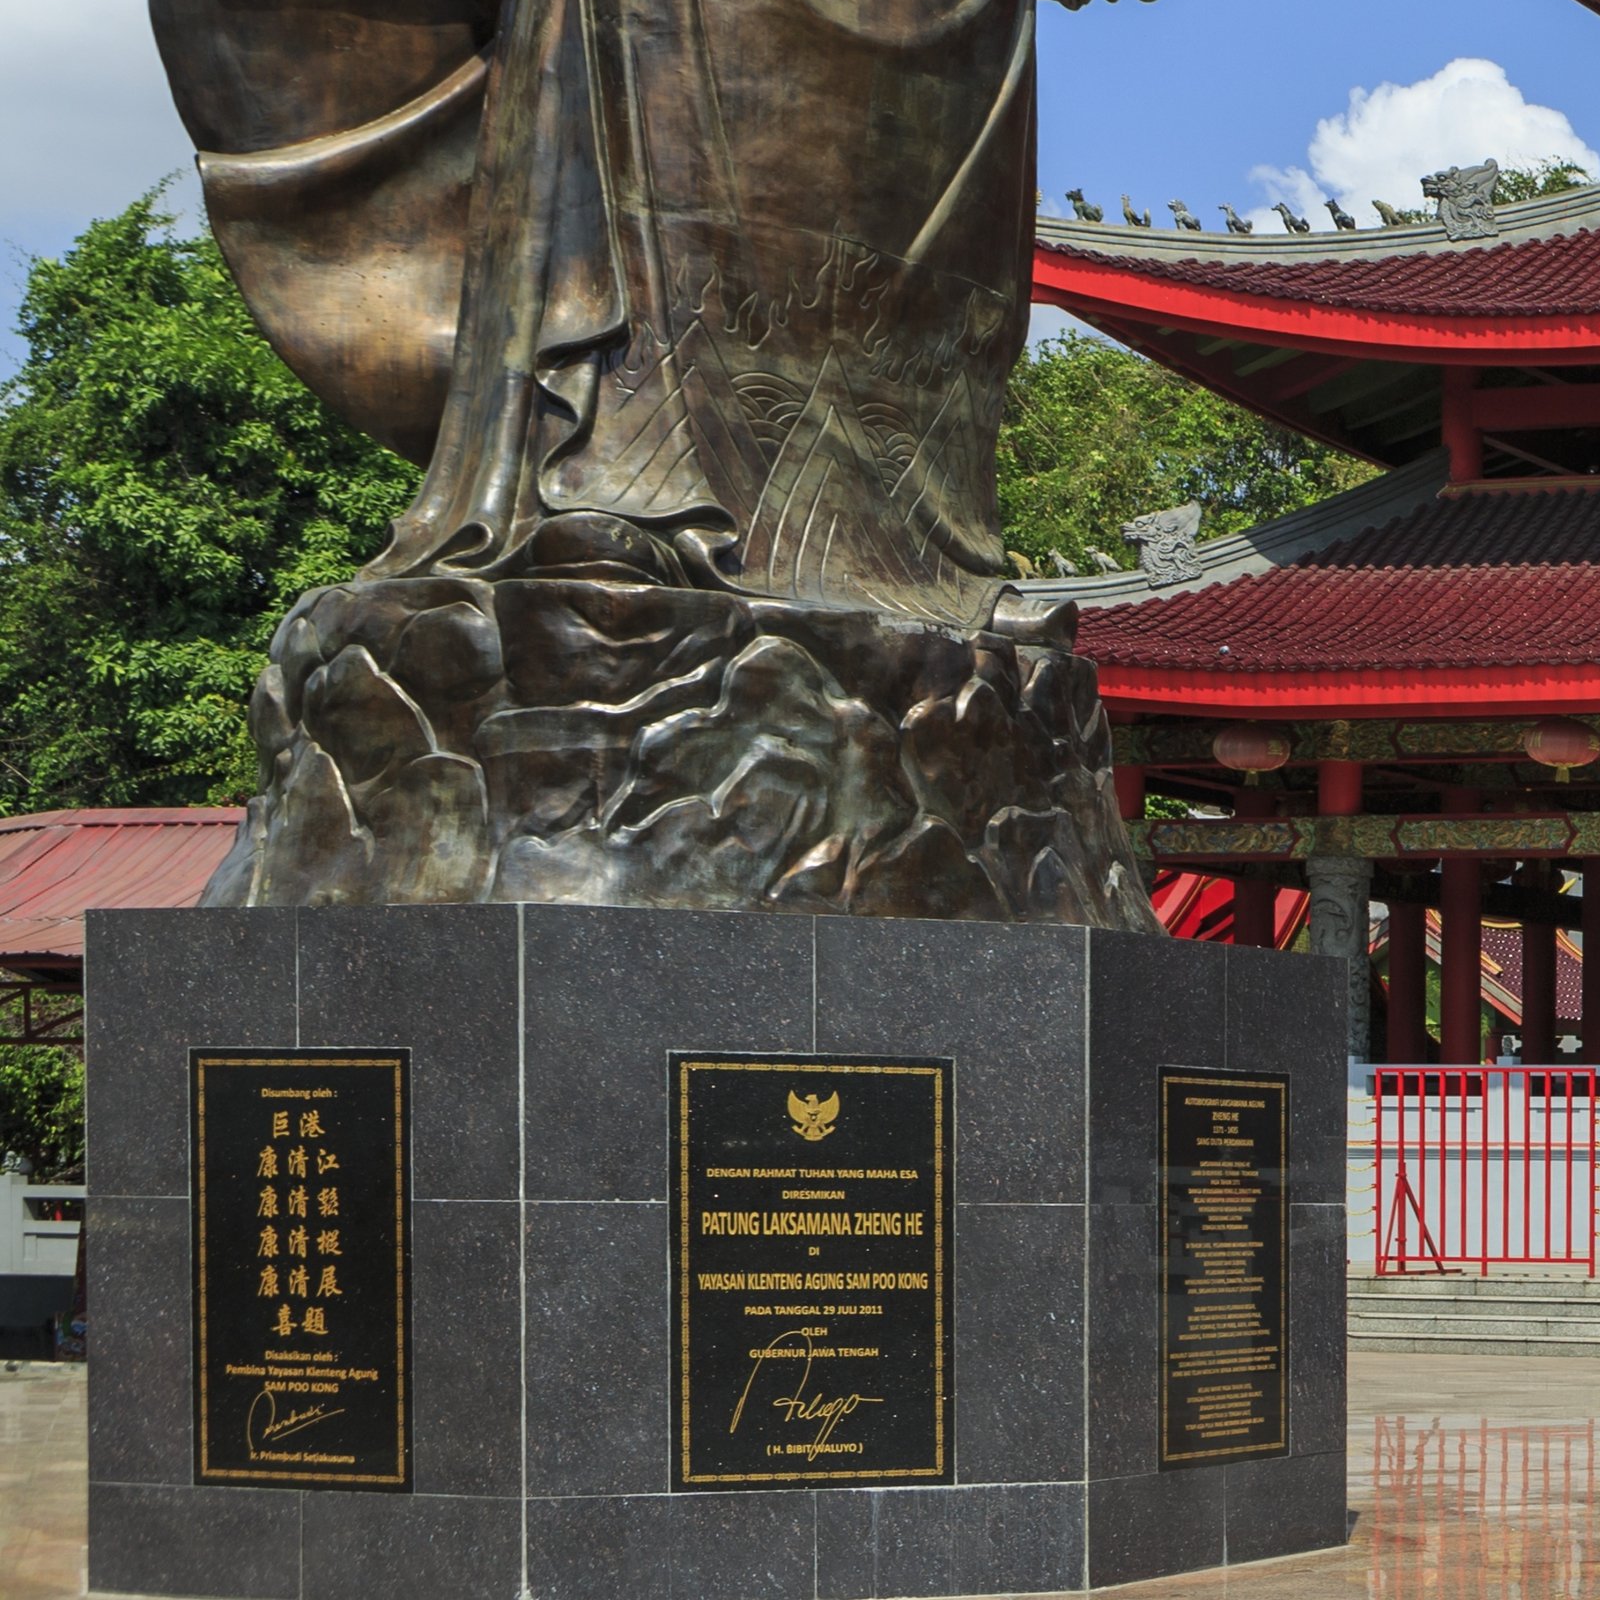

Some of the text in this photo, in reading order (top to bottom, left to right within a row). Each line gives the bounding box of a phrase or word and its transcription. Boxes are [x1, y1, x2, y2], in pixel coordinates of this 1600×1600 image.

[262, 1088, 310, 1099] Disumbang
[313, 1088, 332, 1097] oleh
[272, 1110, 325, 1138] 巨港
[258, 1146, 340, 1178] 康清江
[706, 1168, 918, 1179] DENGAN RAHMAT TUHAN YANG MAHA ESA
[782, 1190, 845, 1200] DIRESMIKAN
[702, 1212, 923, 1235] PATUNG LAKSAMANA ZHENG HE
[809, 1247, 820, 1256] DI
[258, 1264, 342, 1298] 康清展
[698, 1273, 928, 1290] YAYASAN KLENTENG AGUNG SAM POO KONG
[745, 1306, 882, 1315] PADA TANGGAL 29 JULI 2011
[801, 1327, 827, 1337] OLEH
[265, 1350, 311, 1361] Disaksikan
[313, 1352, 332, 1362] oleh
[750, 1348, 879, 1358] GUBERNUR JAWA TENGAH
[226, 1364, 378, 1380] Pembina Yayasan Klenteng Agung
[264, 1381, 338, 1393] SAM POO KONG
[786, 1444, 811, 1454] BIBIT
[814, 1443, 857, 1453] WALUYO
